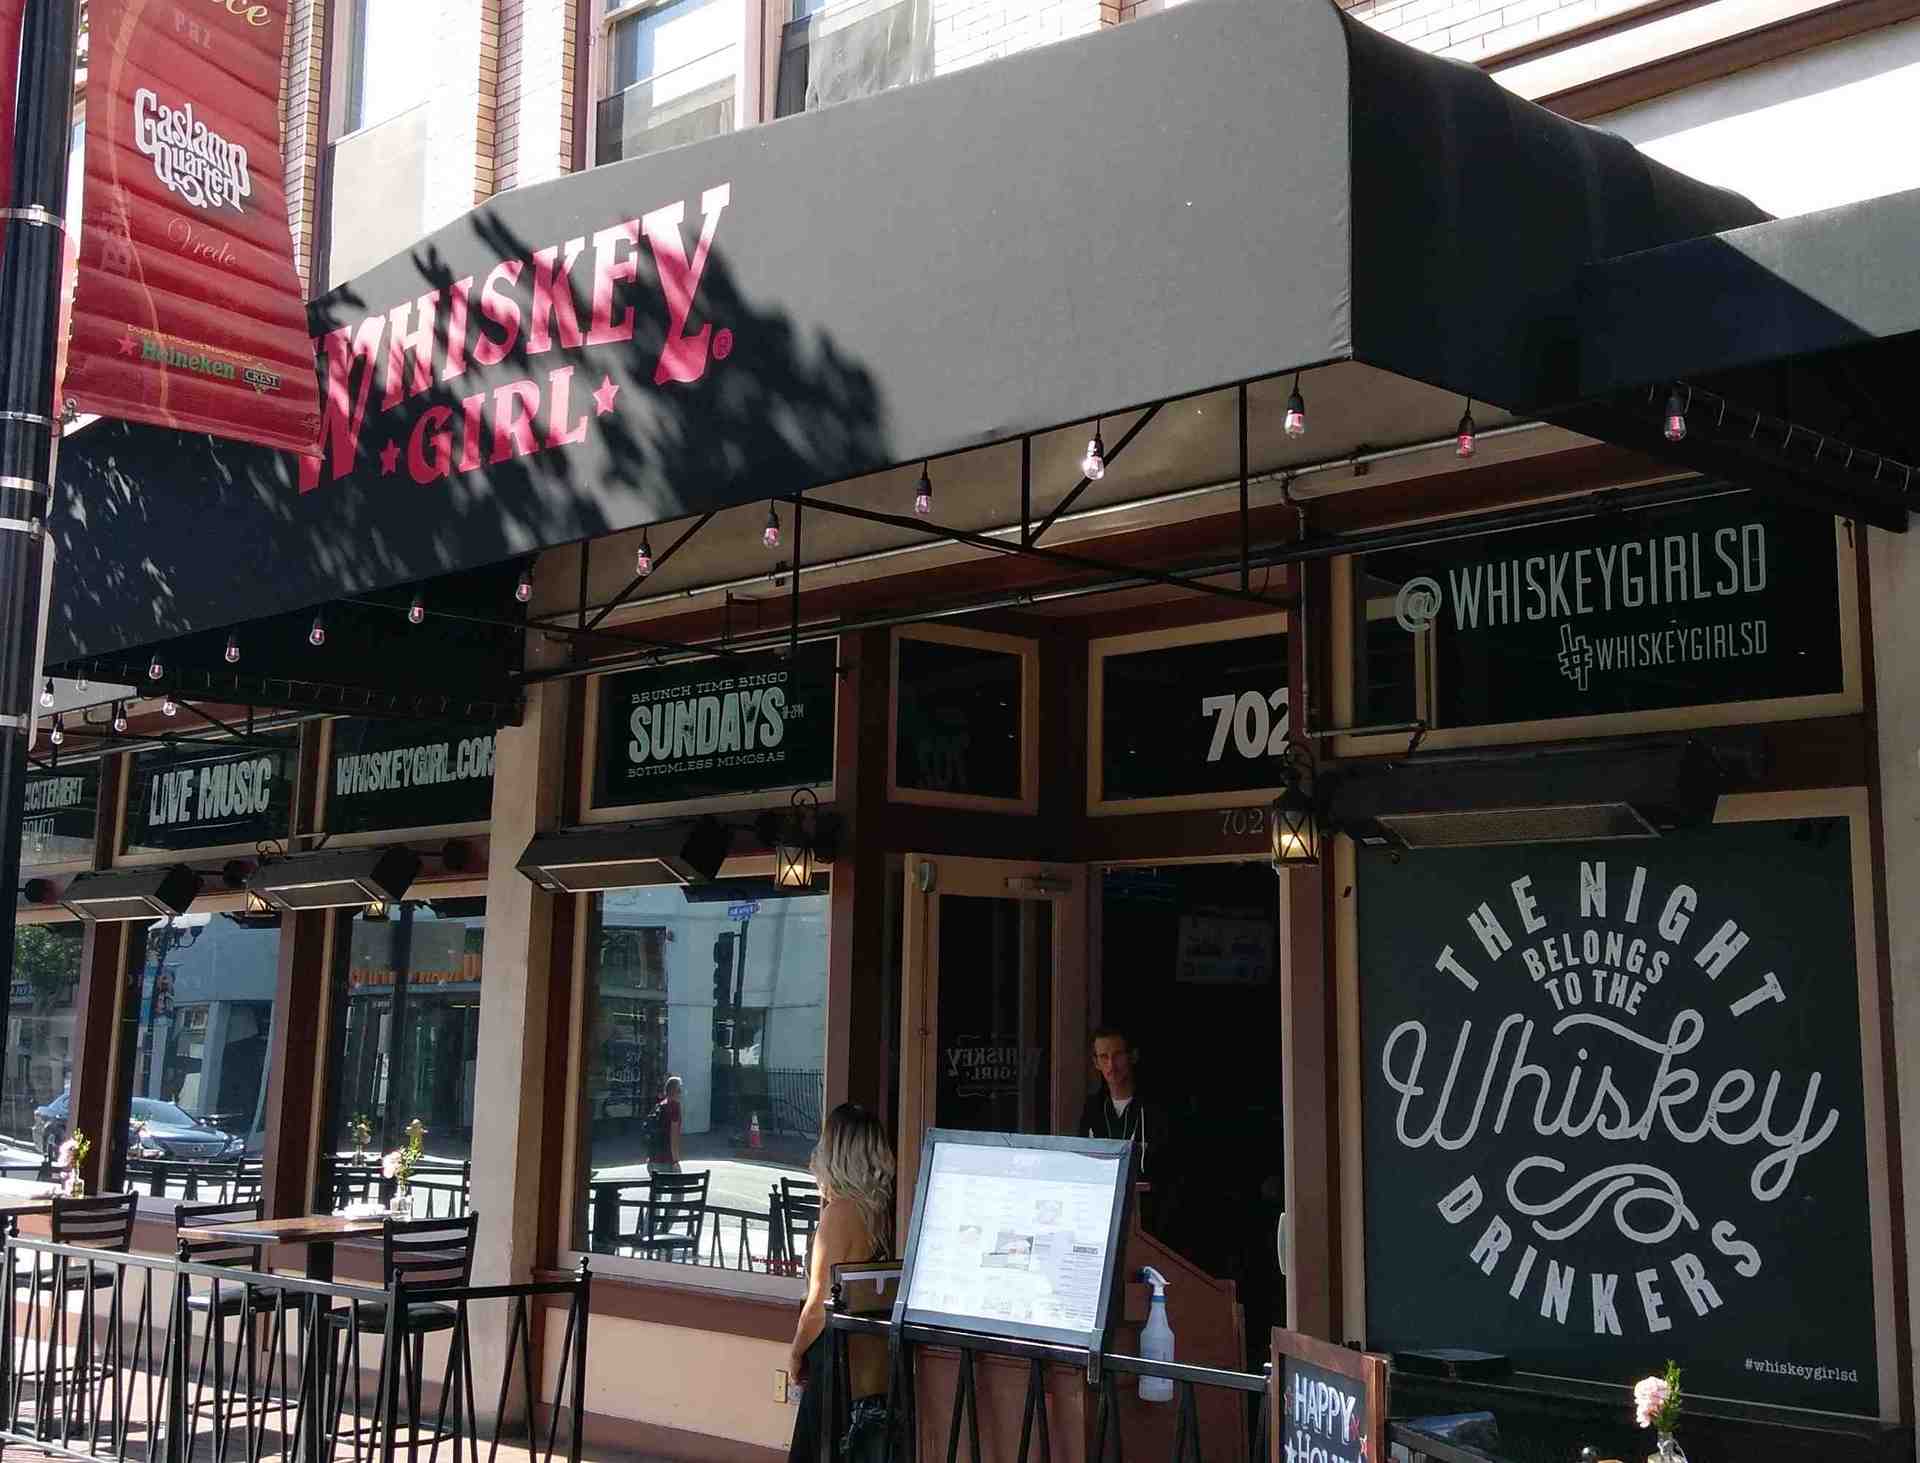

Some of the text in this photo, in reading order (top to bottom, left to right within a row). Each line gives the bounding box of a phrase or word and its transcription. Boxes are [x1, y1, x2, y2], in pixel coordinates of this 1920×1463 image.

[134, 87, 251, 198] Gaslamp
[154, 142, 246, 213] Quarter
[141, 338, 236, 382] Heineken
[299, 182, 731, 496] WHISKEY
[245, 368, 280, 387] CREST
[407, 365, 589, 485] GIRL
[631, 671, 788, 704] BRUNCH TIME BINGO
[1558, 620, 1768, 692] #WHISKEYGIRLSD
[628, 686, 785, 764] SUNDAYS
[1201, 687, 1290, 763] 702
[148, 757, 272, 827] LIVE MUSIC
[336, 734, 498, 796] WHISKEYGIRL.COM
[627, 751, 785, 778] BOTTOMLESS MIMOSAS
[1216, 807, 1264, 836] 702
[1434, 861, 1787, 1018] THE NIGHT
[1521, 928, 1670, 984] BELONGS
[1544, 969, 1649, 1017] TO THE
[1382, 1008, 1840, 1203] Whiskey
[1437, 1174, 1763, 1337] DRINKERS
[1743, 1356, 1859, 1384] #whiskeygirlsd
[1294, 1372, 1357, 1443] HAPPY
